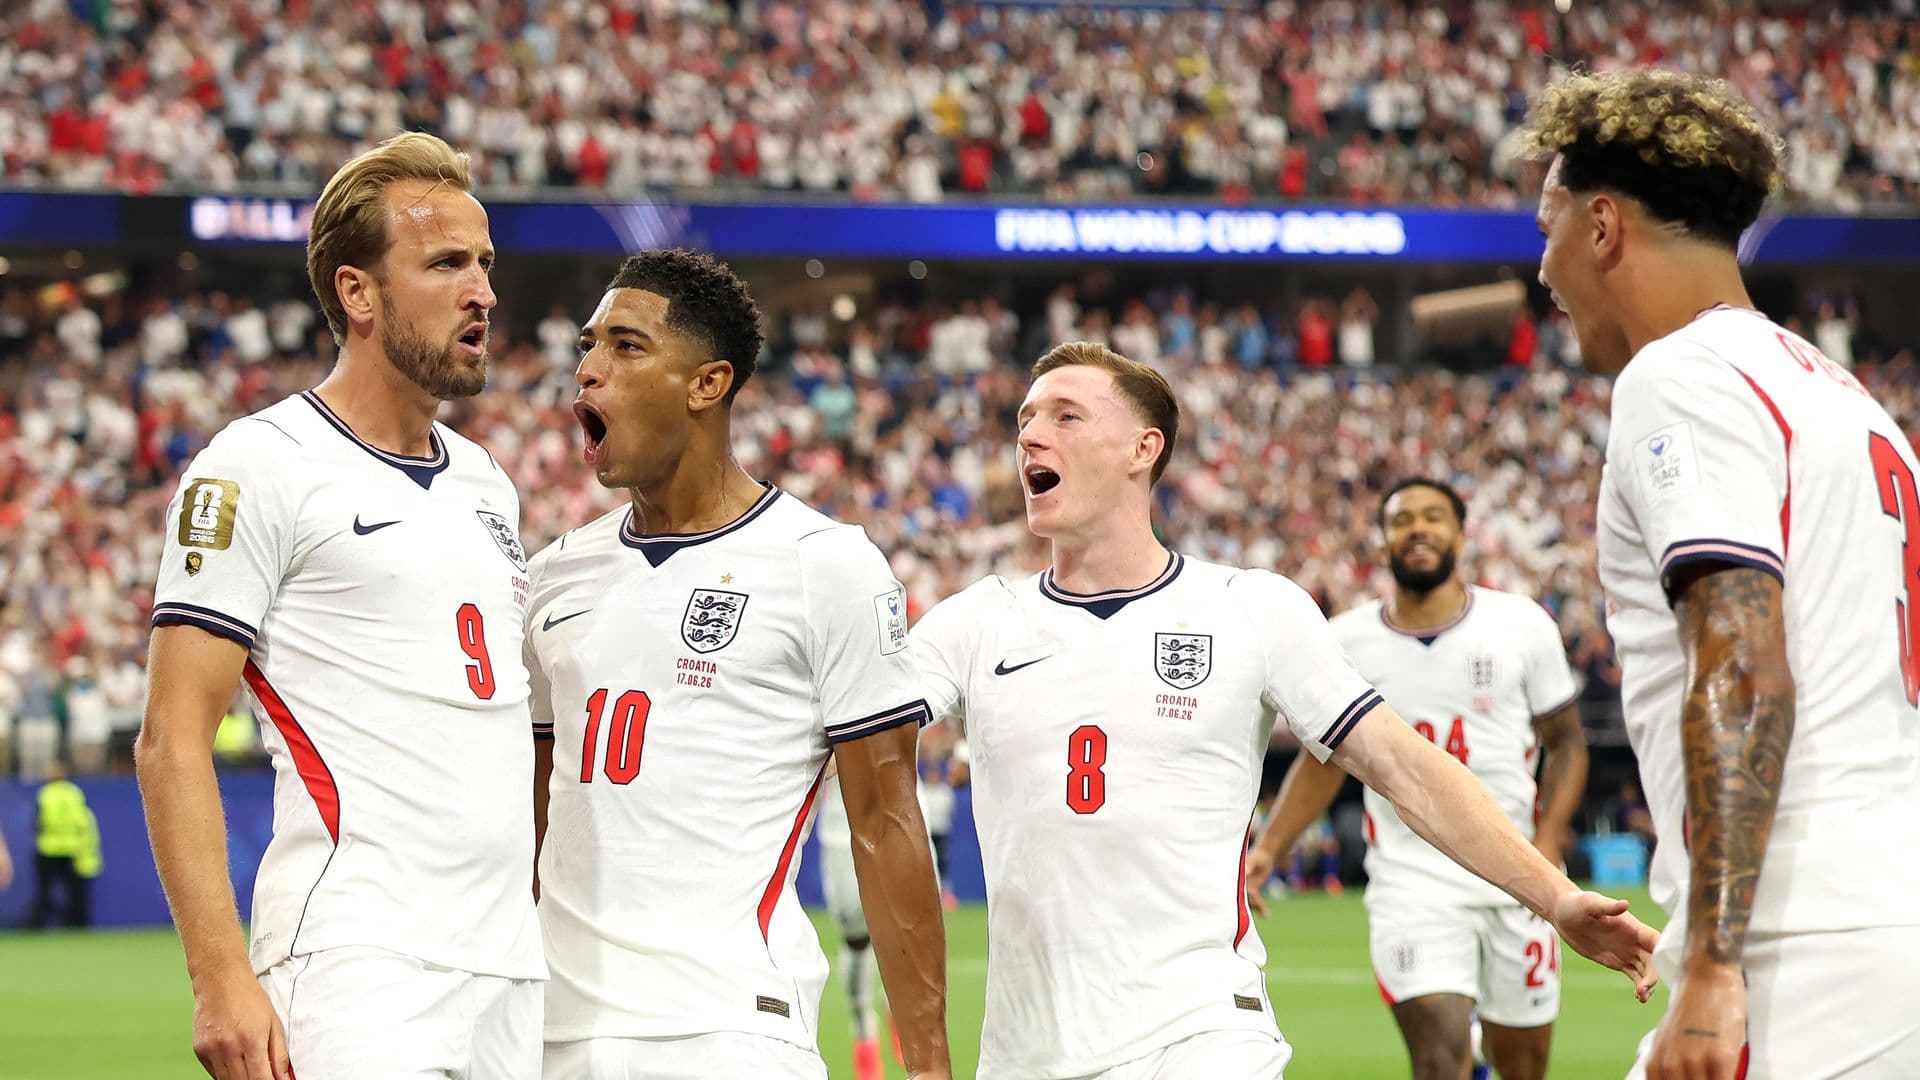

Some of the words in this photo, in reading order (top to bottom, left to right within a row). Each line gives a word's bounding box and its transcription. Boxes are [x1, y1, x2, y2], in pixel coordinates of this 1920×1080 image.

[996, 208, 1077, 251] FIFA
[1075, 209, 1203, 252] WORLD
[1206, 211, 1277, 252] CUP
[189, 534, 215, 543] 2026
[455, 602, 496, 700] 9
[676, 657, 717, 675] CROATIA
[676, 672, 712, 689] 17.06.26
[1155, 693, 1198, 708] CROATIA
[1156, 707, 1193, 721] 17.06.26
[580, 688, 651, 785] 10
[1066, 725, 1107, 815] 8
